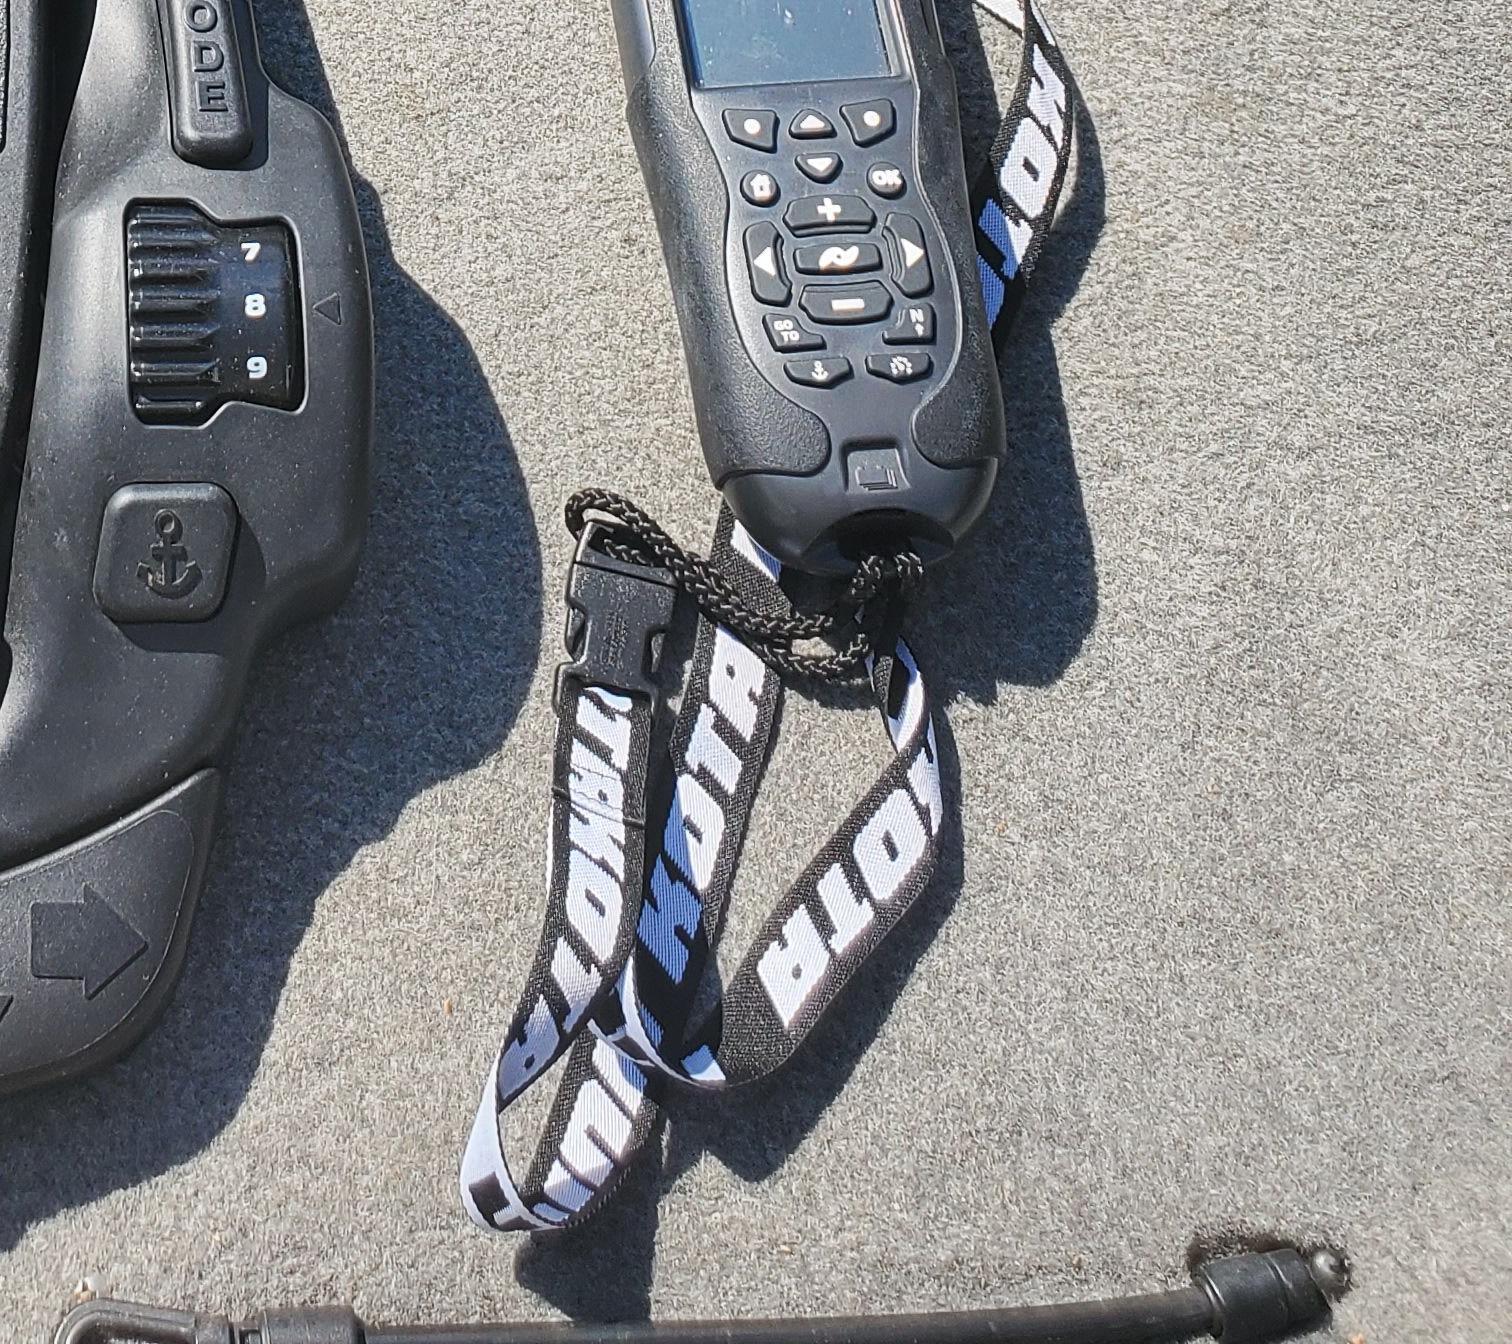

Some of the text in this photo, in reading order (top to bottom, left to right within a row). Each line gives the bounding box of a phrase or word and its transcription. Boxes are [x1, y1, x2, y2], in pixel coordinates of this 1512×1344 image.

[871, 168, 903, 186] OK
[241, 242, 261, 262] 7
[244, 293, 267, 317] 8
[773, 319, 795, 331] GO
[908, 308, 924, 323] N
[780, 331, 800, 343] TO
[246, 356, 268, 379] 9
[637, 625, 767, 985] KOTA
